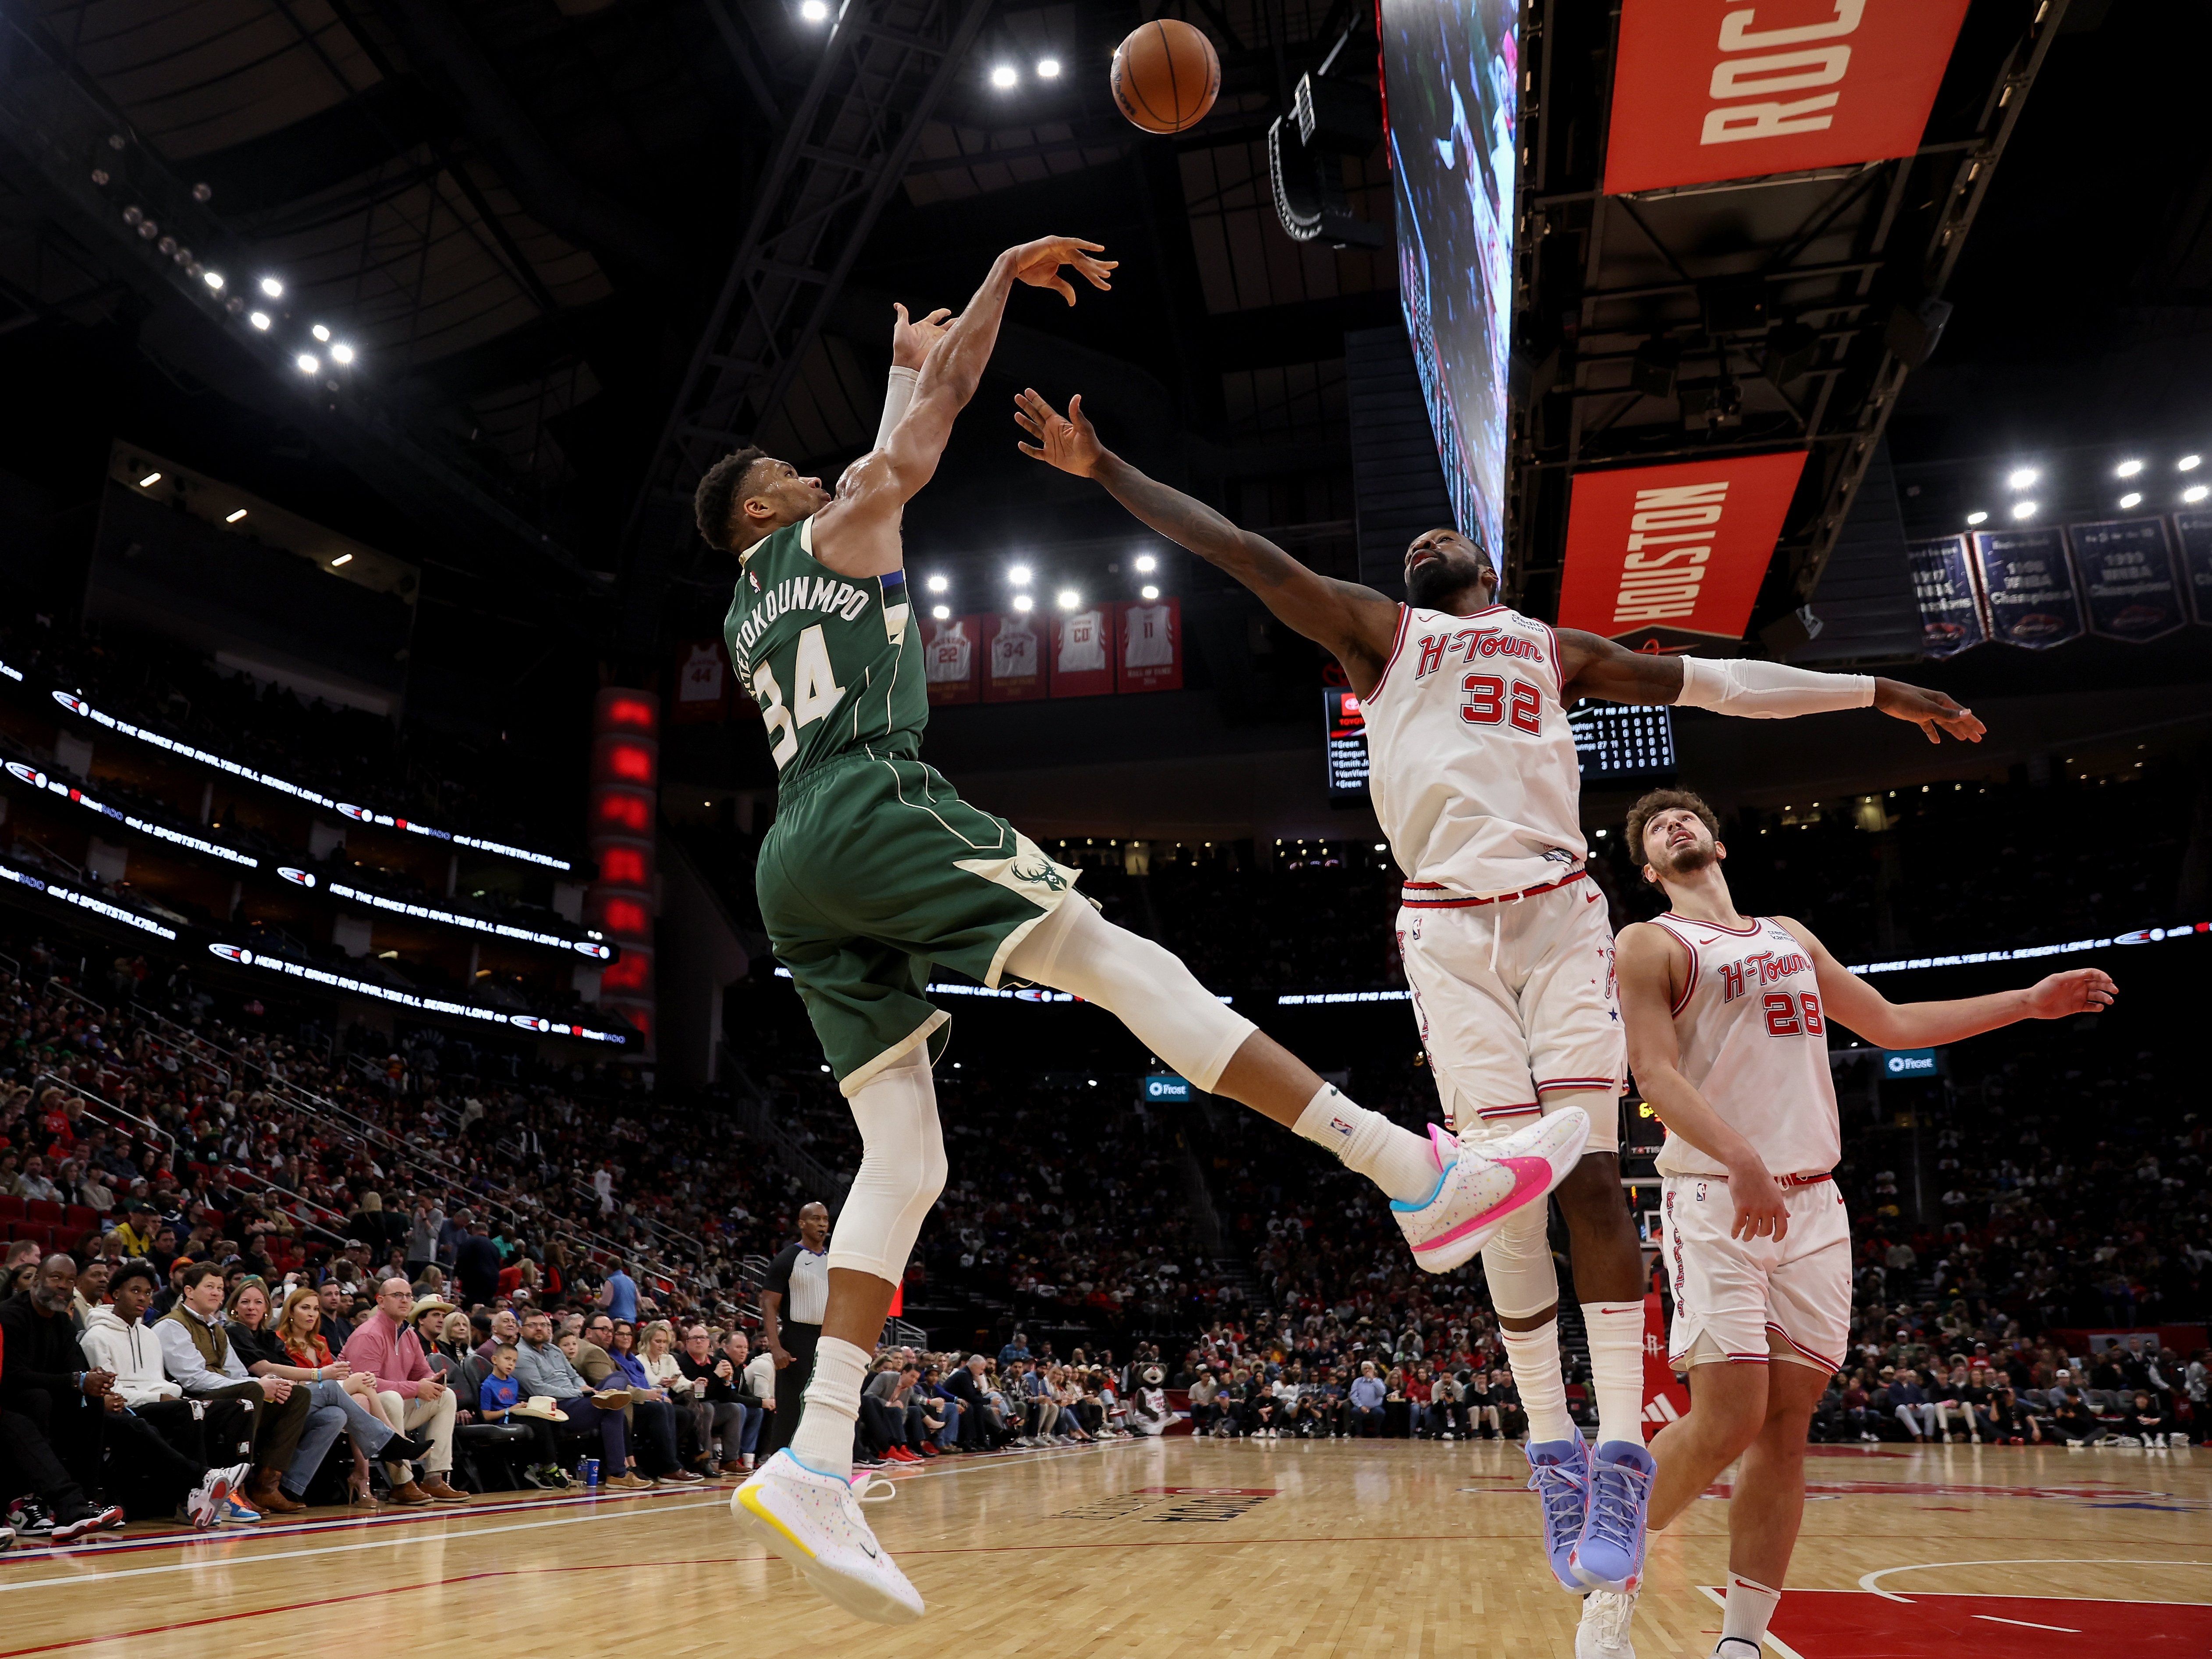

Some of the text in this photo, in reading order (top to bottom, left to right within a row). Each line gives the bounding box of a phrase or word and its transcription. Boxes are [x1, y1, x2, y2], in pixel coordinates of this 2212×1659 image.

[1700, 0, 1865, 145] ROC
[1613, 481, 1729, 622] HOUSTON
[1512, 617, 1544, 632] karma
[938, 647, 957, 663] 22
[1415, 627, 1544, 680] H-Town
[753, 624, 846, 771] 34
[1460, 673, 1542, 737] 32
[1647, 717, 1652, 725] 0
[1659, 716, 1665, 725] 0
[1635, 728, 1641, 736] 0
[1660, 726, 1666, 735] 0
[1598, 741, 1607, 749] 27
[1339, 760, 1361, 768] Smith
[1614, 760, 1620, 769] 0
[1626, 760, 1632, 768] 0
[1639, 759, 1645, 767] 0
[1651, 758, 1657, 766] 0
[1988, 951, 2011, 961] ALL
[1720, 950, 1812, 1004] H-Town
[403, 995, 421, 1007] ALL
[1306, 995, 1324, 1003] THE
[1358, 992, 1379, 1001] AND
[1762, 991, 1825, 1038] 28
[1904, 1058, 1934, 1069] Frost
[1163, 1084, 1186, 1095] Frost
